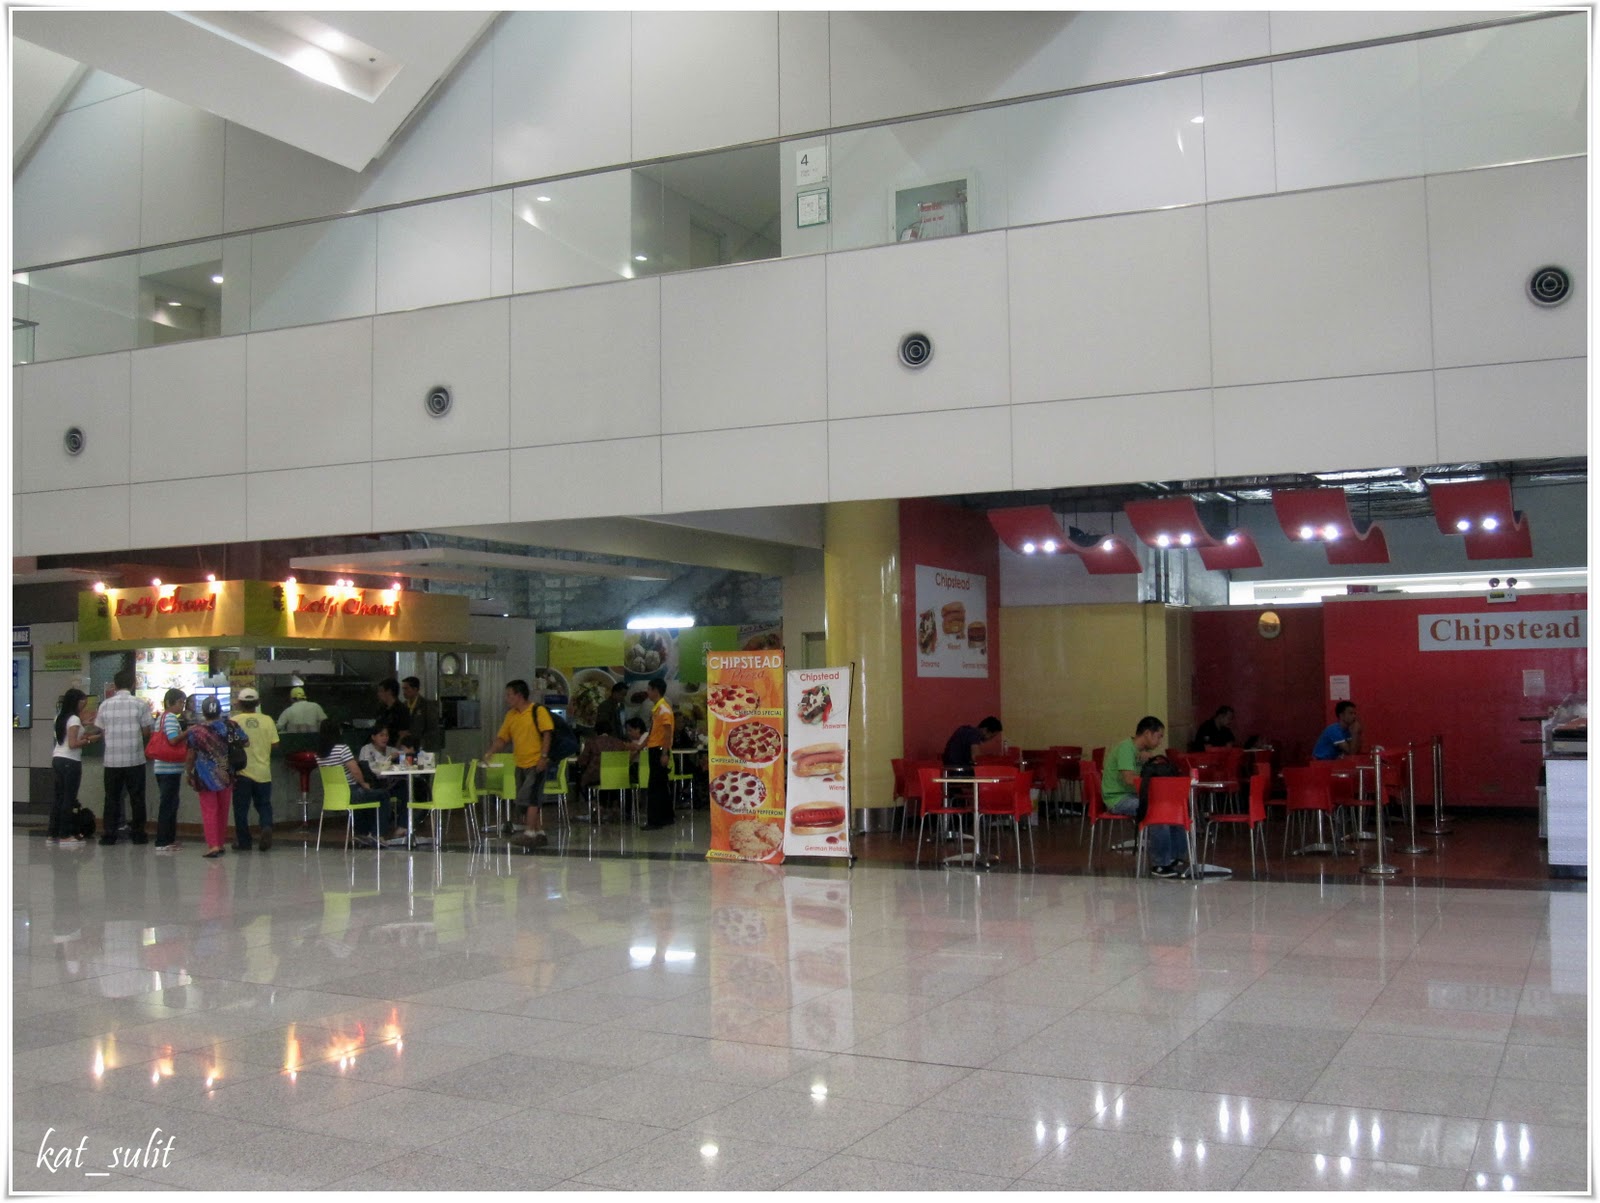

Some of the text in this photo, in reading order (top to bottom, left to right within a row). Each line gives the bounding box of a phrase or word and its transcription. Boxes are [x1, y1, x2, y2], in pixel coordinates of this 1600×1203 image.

[800, 153, 809, 166] 4
[936, 572, 971, 590] Chipstead
[1429, 615, 1581, 647] Chipstead
[709, 655, 782, 669] CHIPSTEAD
[800, 672, 840, 682] Chipstead
